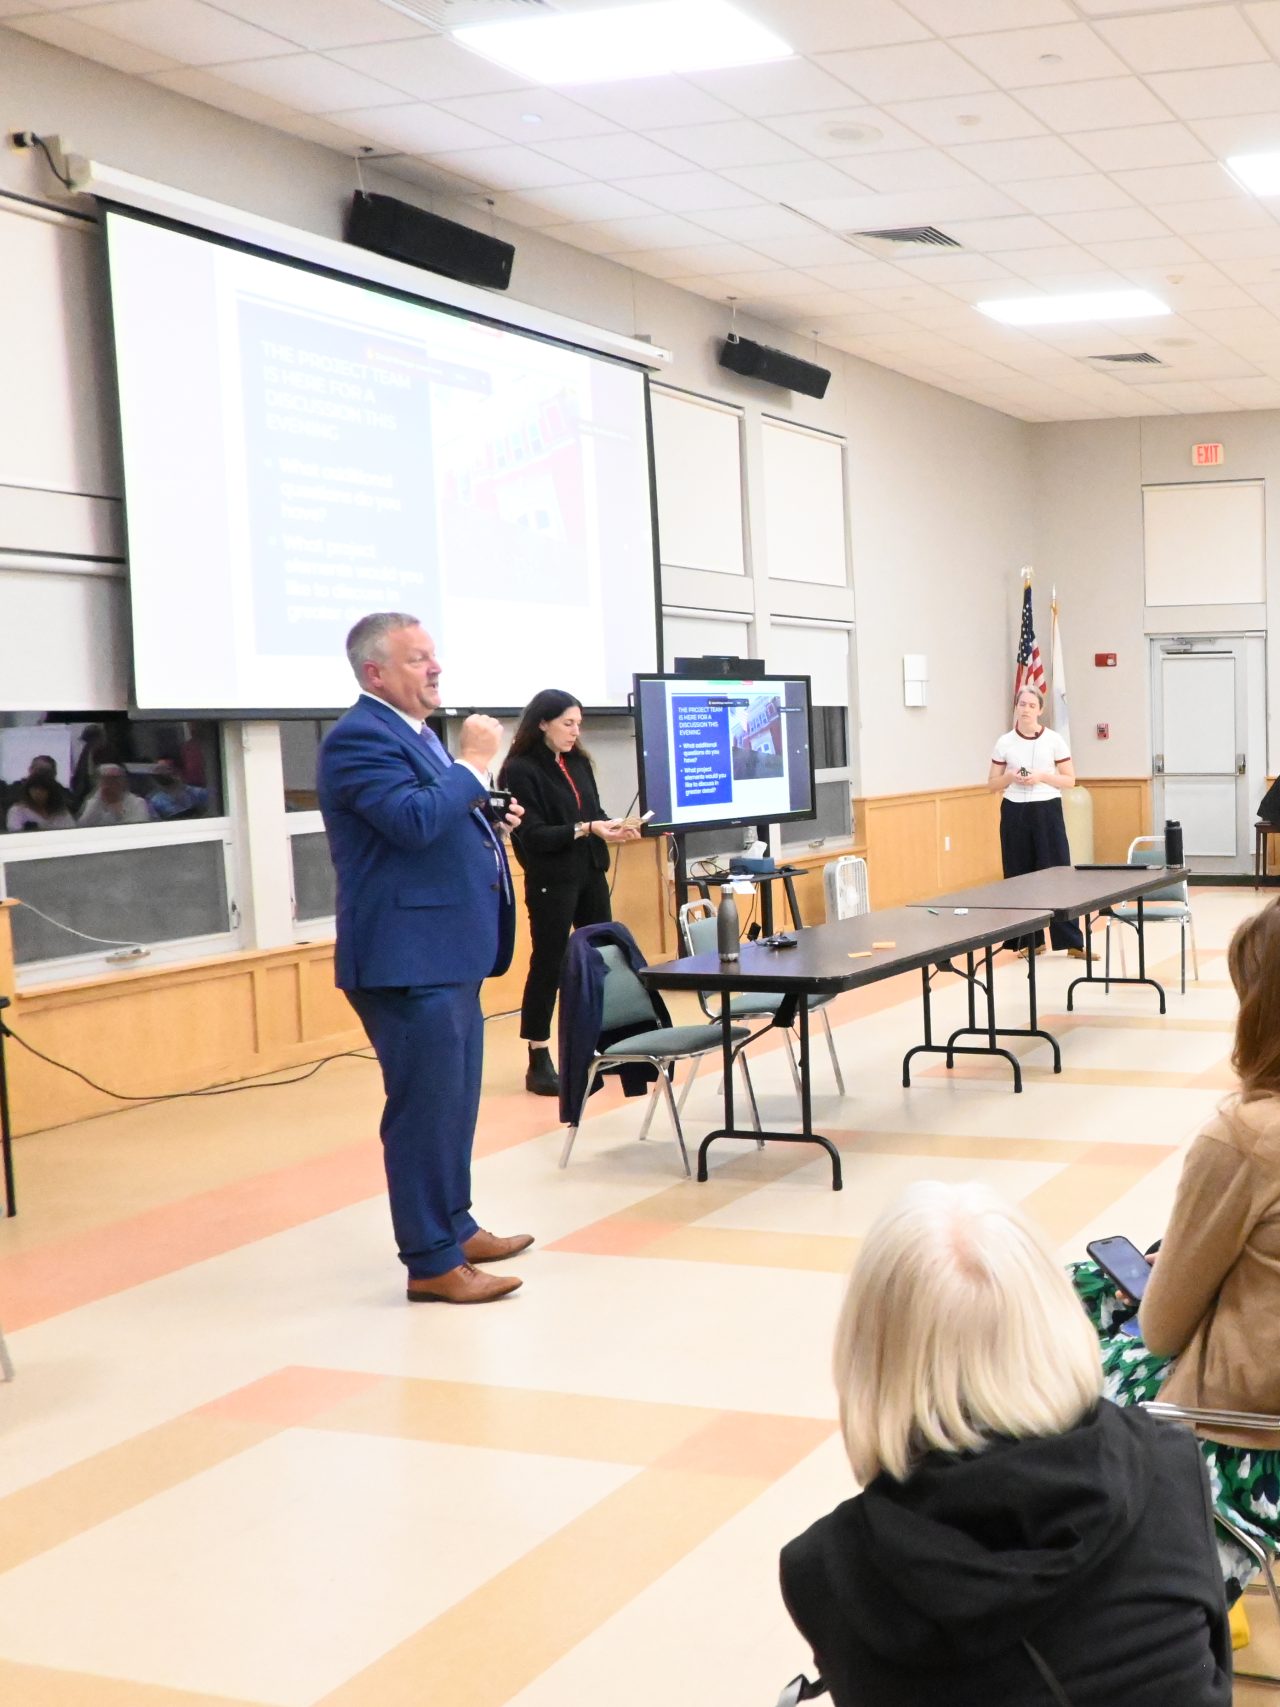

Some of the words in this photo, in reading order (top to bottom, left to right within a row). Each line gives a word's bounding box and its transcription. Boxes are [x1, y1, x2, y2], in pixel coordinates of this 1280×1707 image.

[261, 339, 295, 364] THE
[298, 349, 368, 380] PROJECT
[371, 367, 411, 390] TEAM
[281, 368, 325, 394] HERE
[329, 379, 361, 400] FOR
[264, 388, 361, 424] DISCUSSION
[362, 409, 396, 430] THIS
[1197, 445, 1220, 464] EXIT
